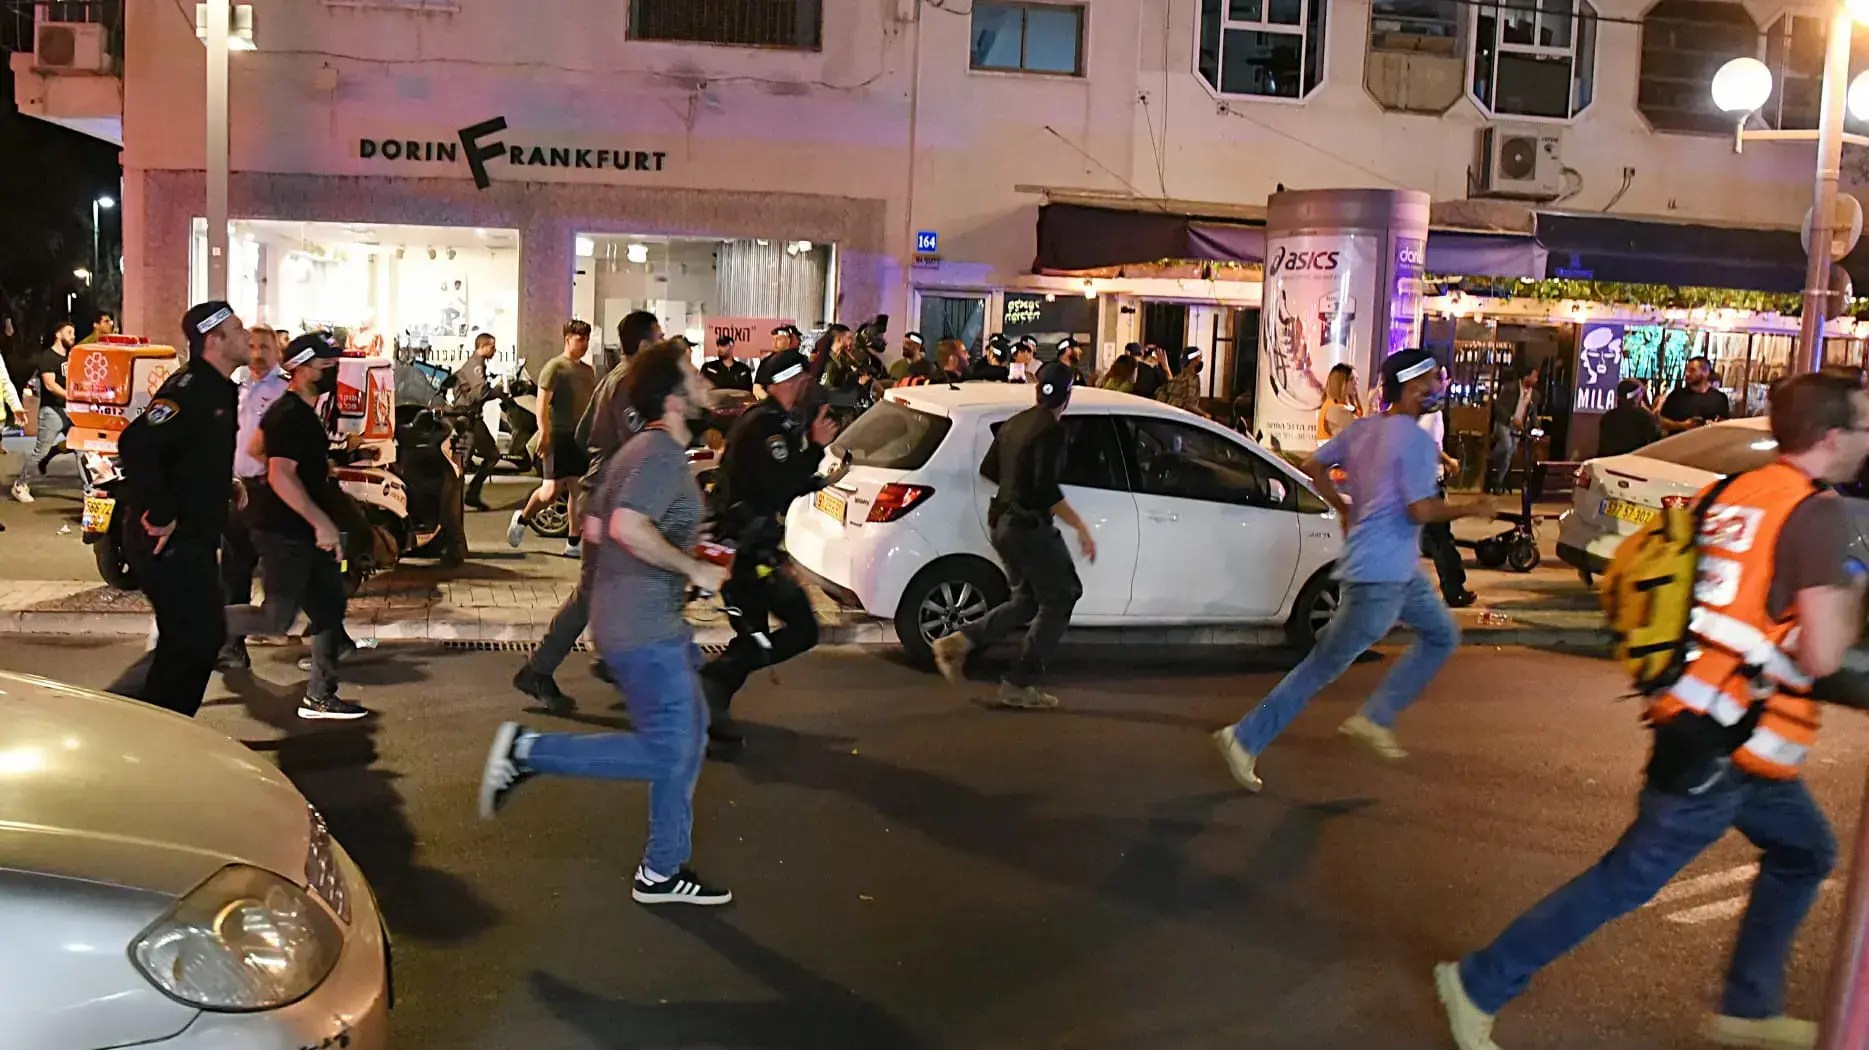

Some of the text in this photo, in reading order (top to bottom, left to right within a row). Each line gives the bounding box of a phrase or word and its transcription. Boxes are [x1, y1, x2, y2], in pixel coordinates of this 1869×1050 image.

[360, 116, 667, 190] DORIN FRANKFURT
[918, 235, 936, 249] 164
[1285, 250, 1340, 271] asics
[1577, 386, 1616, 410] MILA
